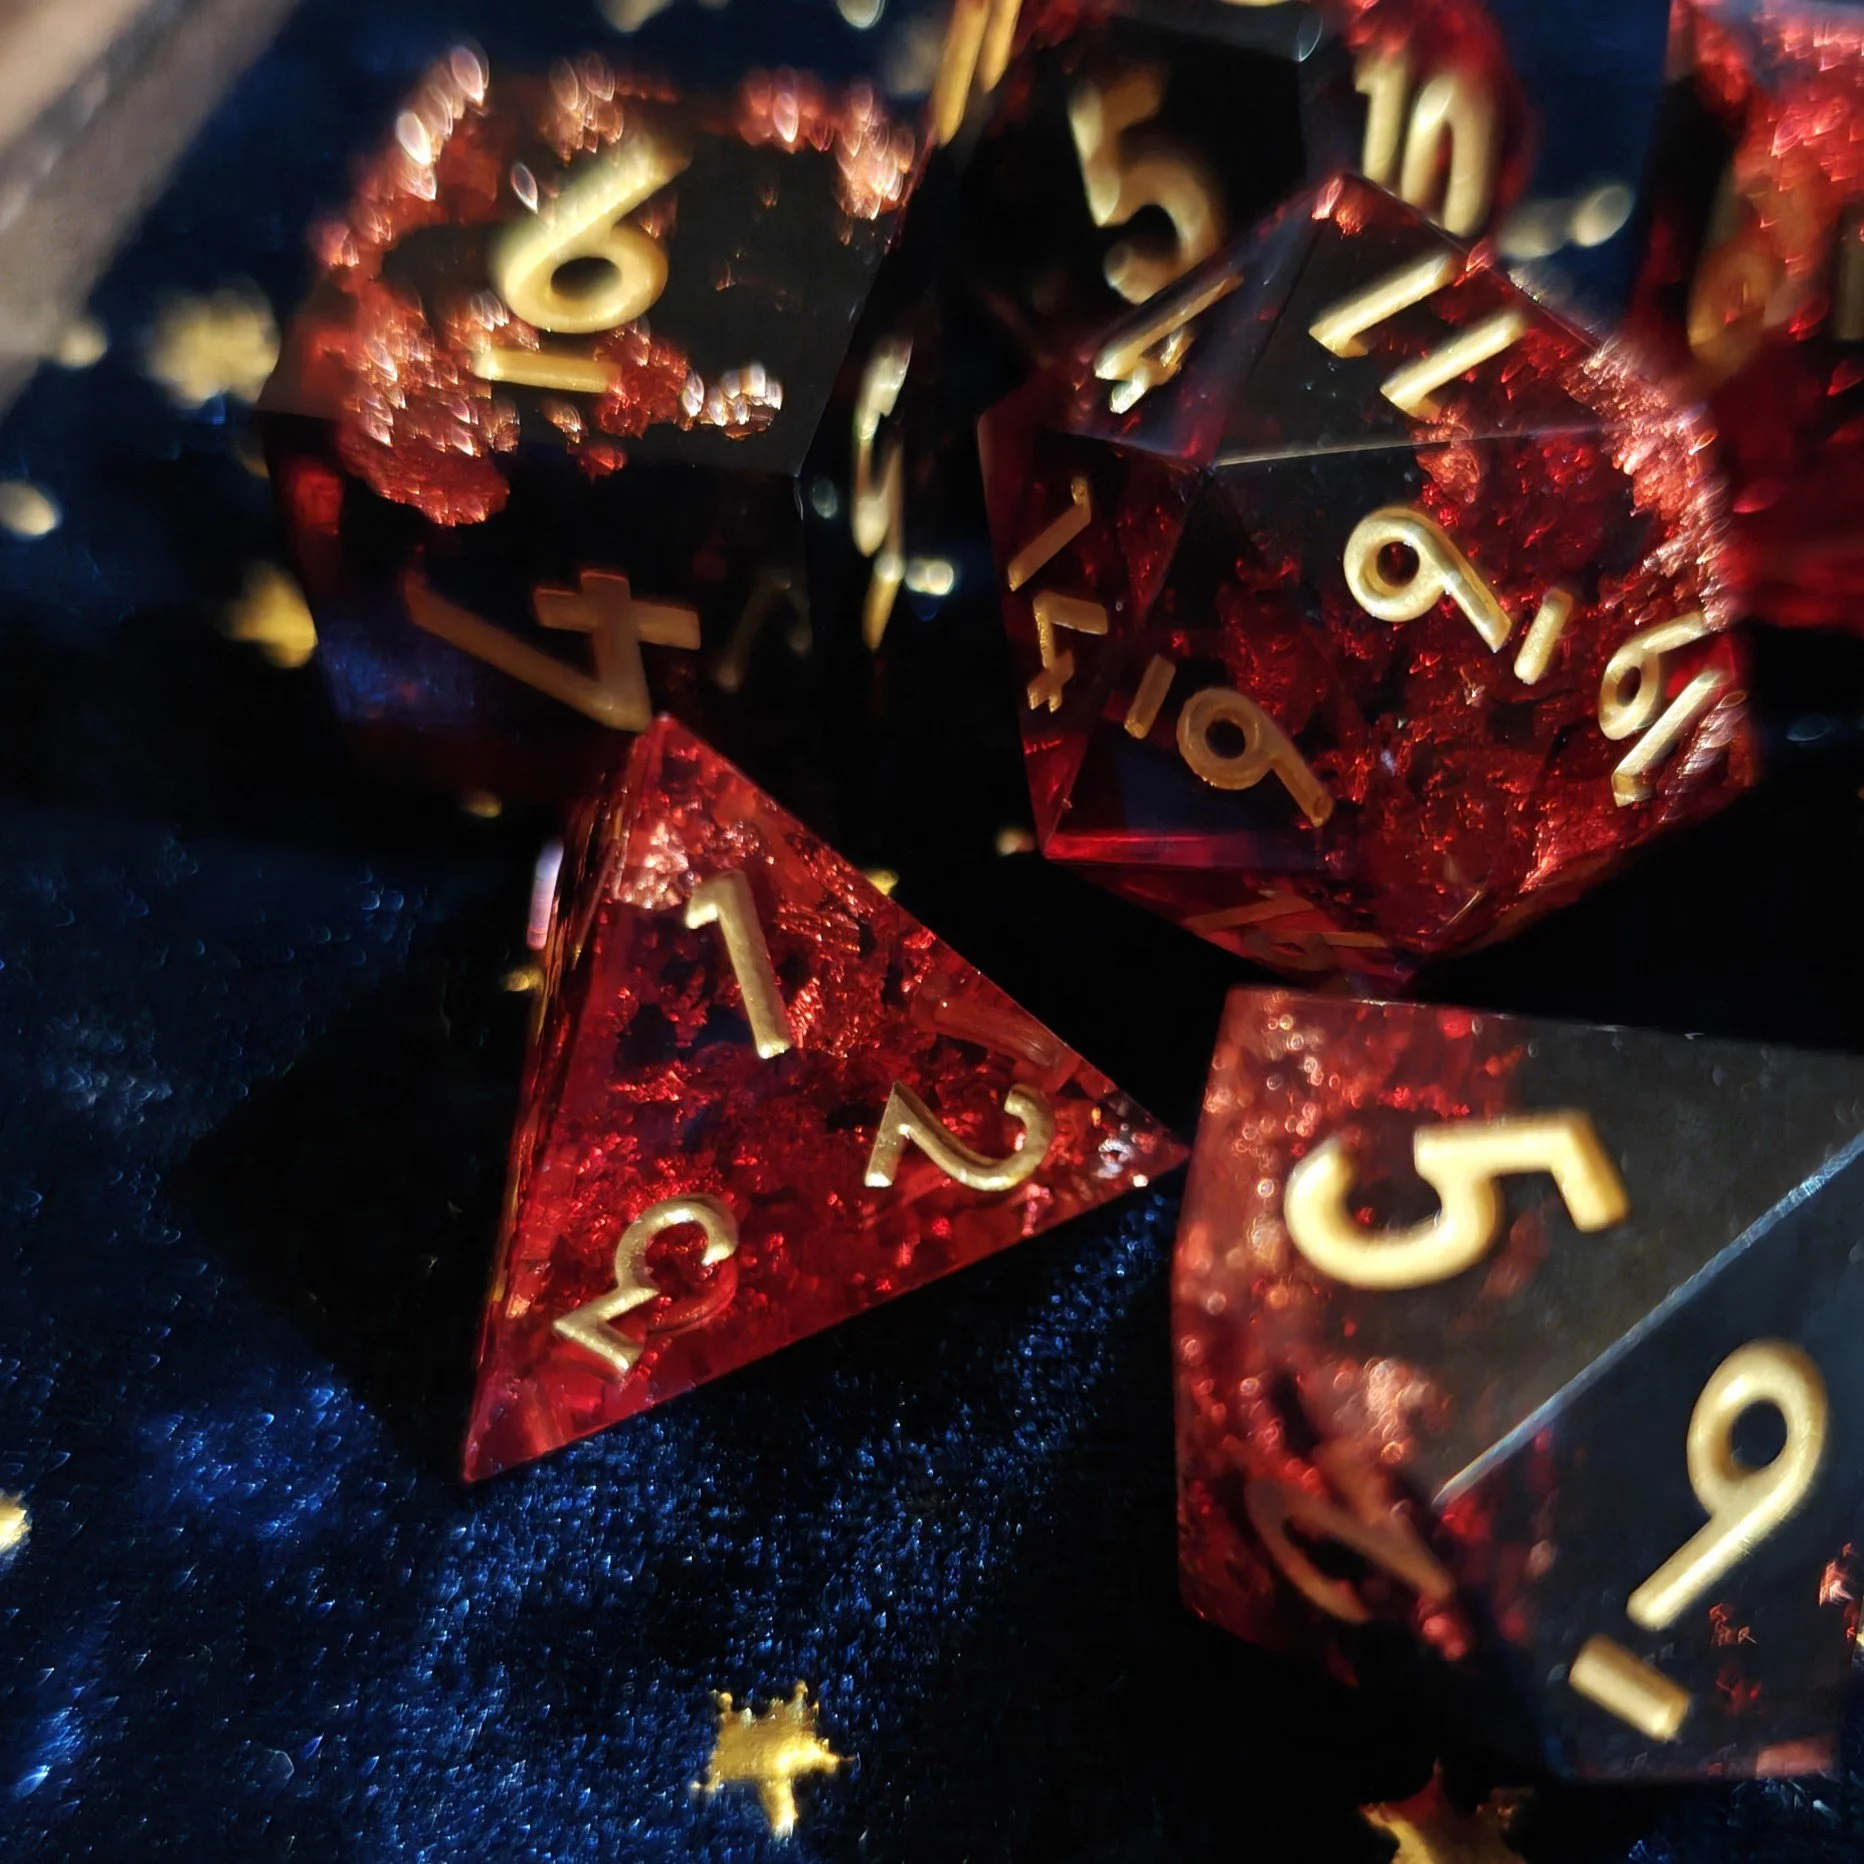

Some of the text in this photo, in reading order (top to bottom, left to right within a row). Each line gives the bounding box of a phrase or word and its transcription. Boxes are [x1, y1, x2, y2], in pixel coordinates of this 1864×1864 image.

[490, 130, 690, 334] 6
[1068, 62, 1222, 305] 5
[1308, 254, 1526, 420] 11
[402, 570, 702, 732] 4
[1344, 506, 1513, 653] 9
[686, 869, 793, 1060] 1
[864, 1079, 1055, 1192] 2
[1284, 1108, 1629, 1290] 5
[552, 1196, 738, 1376] 3
[1627, 1338, 1829, 1631] 9
